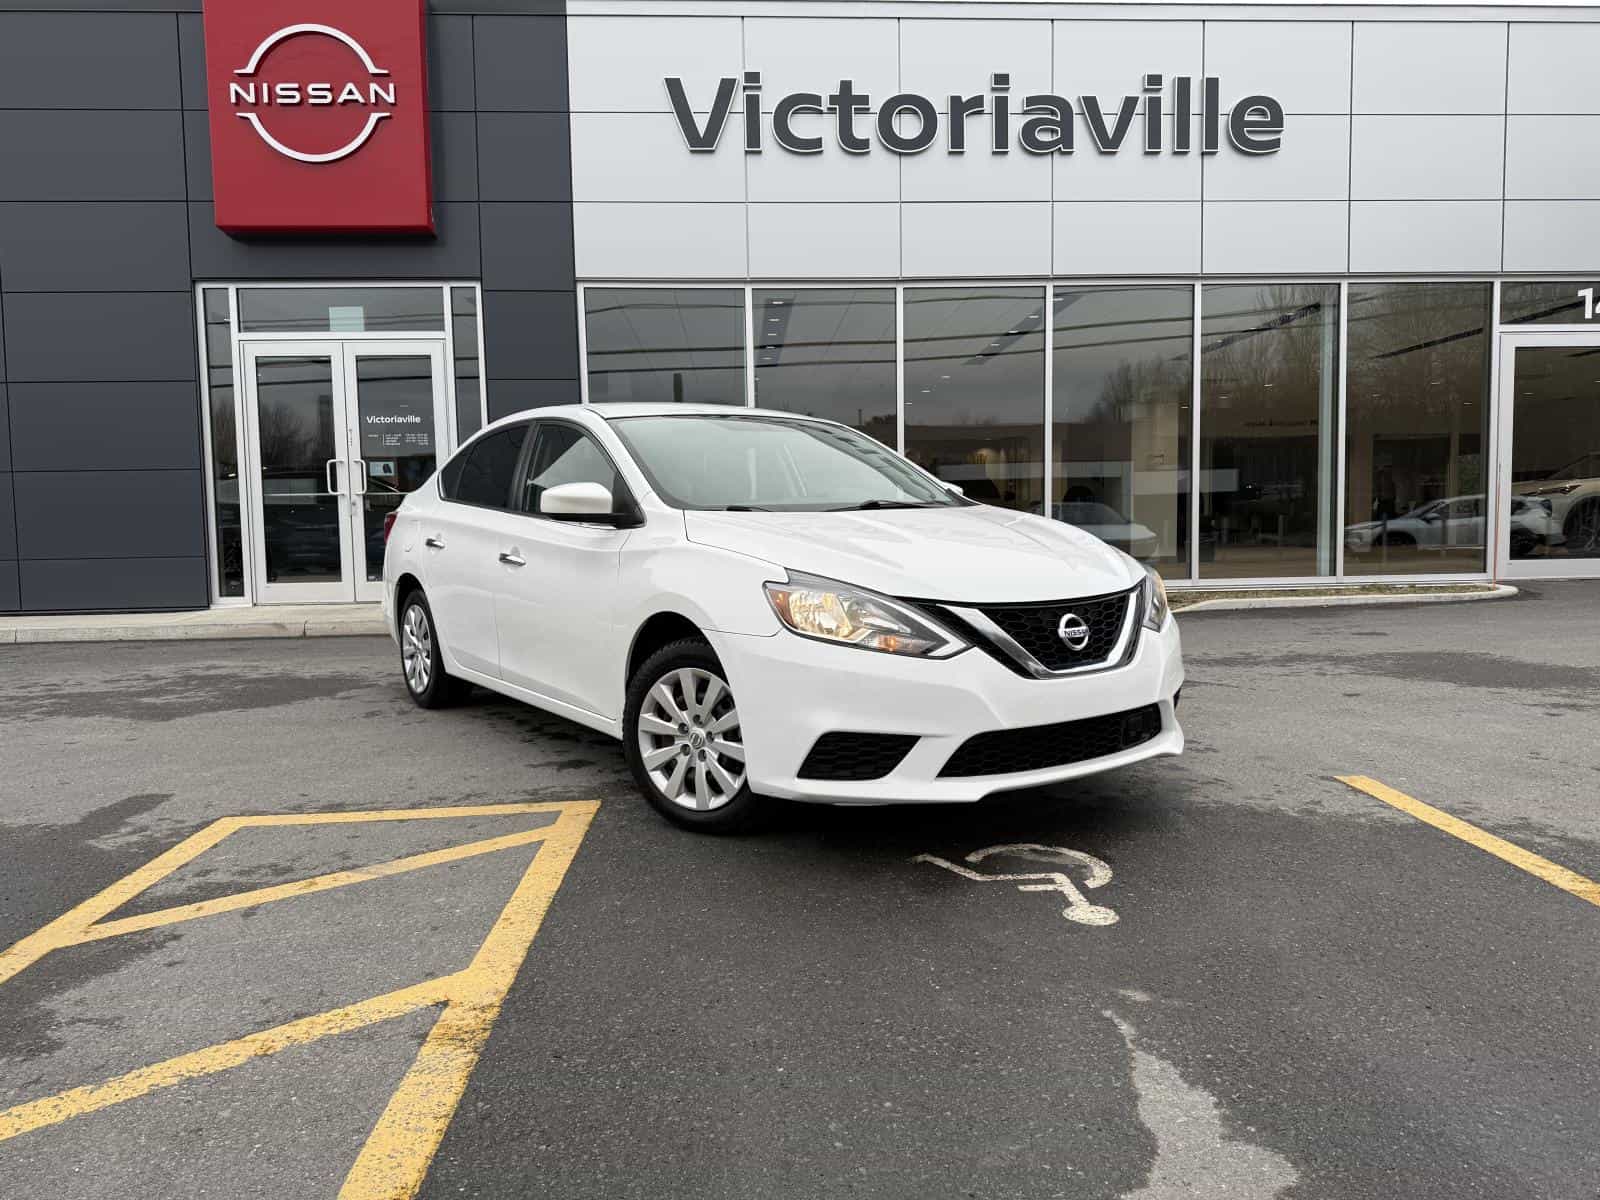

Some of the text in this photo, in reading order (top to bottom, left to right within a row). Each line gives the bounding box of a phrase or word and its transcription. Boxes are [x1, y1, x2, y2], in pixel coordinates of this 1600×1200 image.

[229, 82, 396, 104] NISSAN
[663, 71, 1285, 154] Victoriaville
[366, 414, 421, 424] Victoriaville
